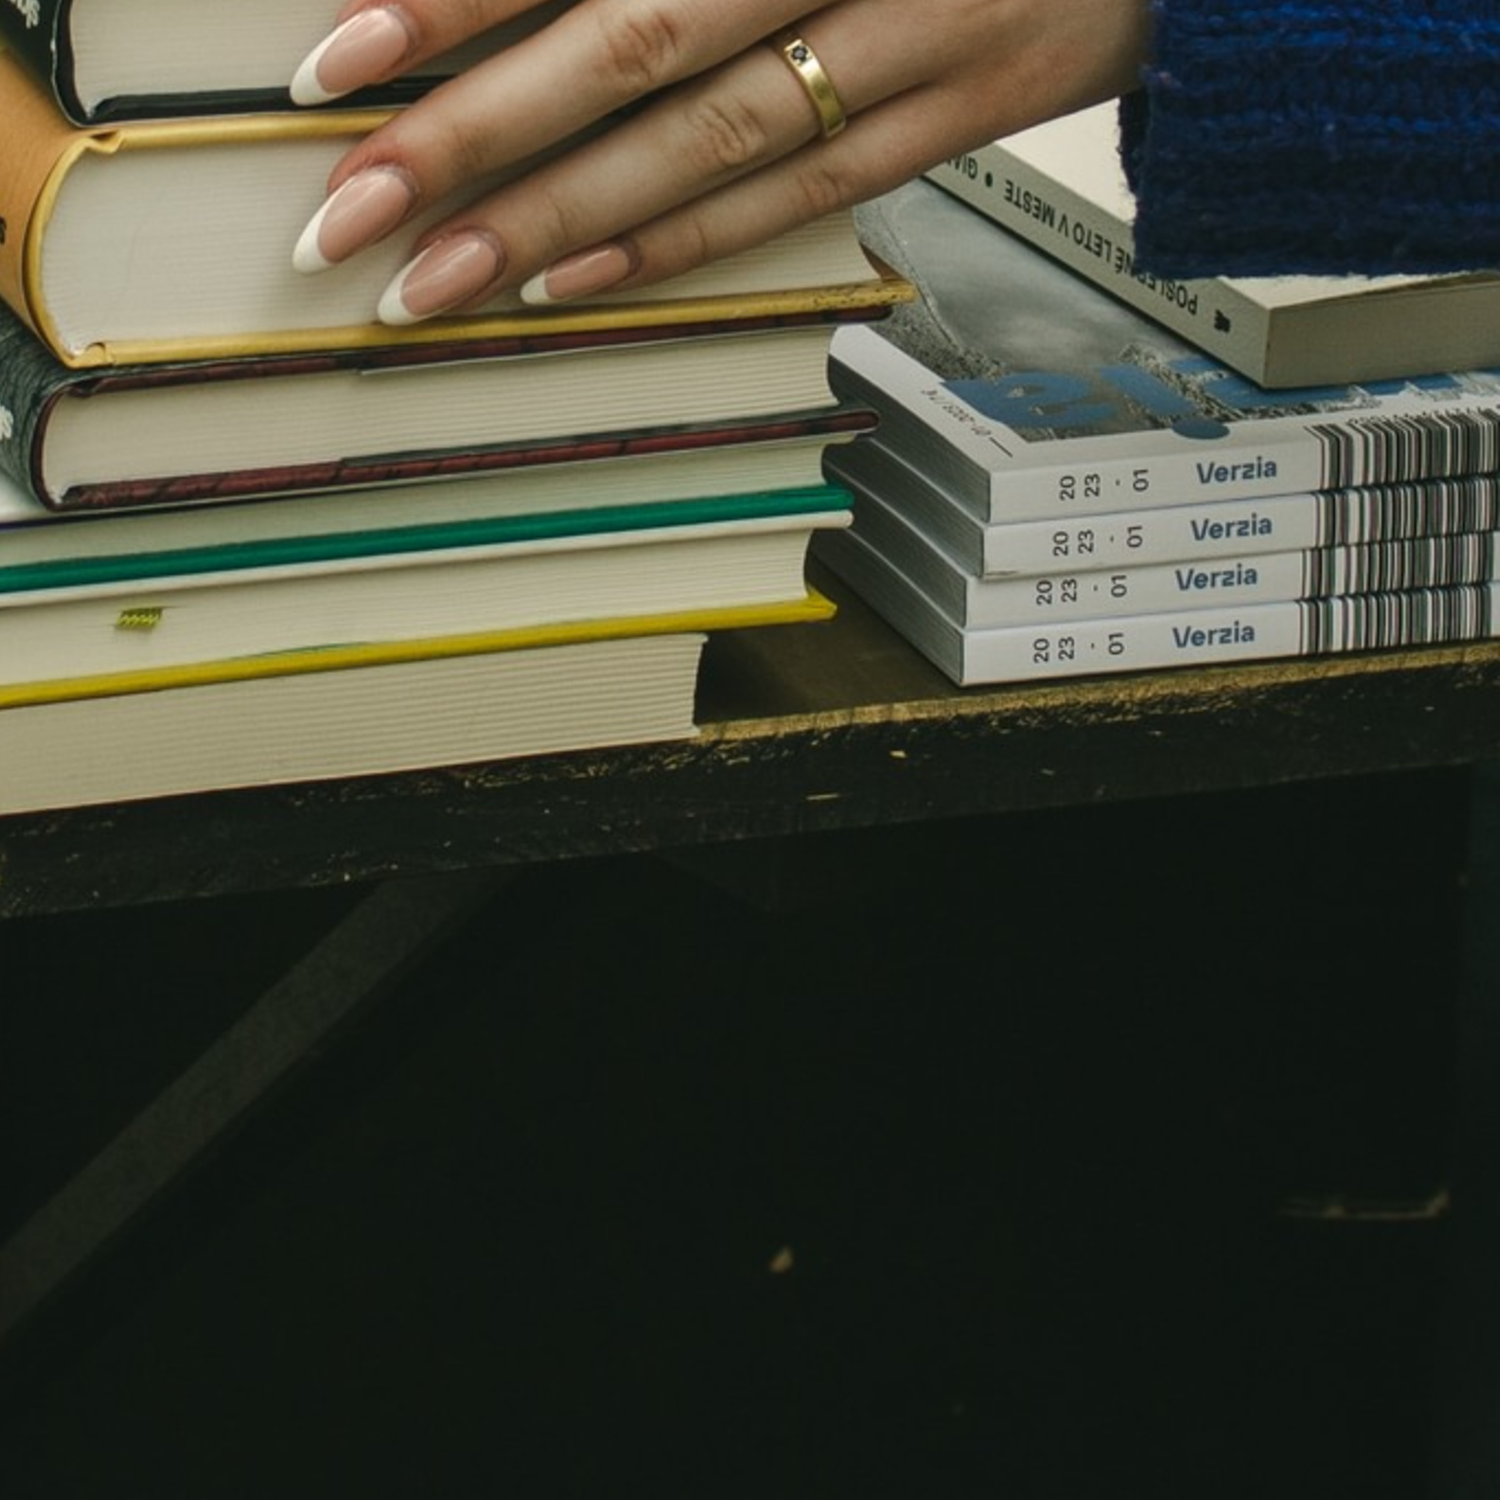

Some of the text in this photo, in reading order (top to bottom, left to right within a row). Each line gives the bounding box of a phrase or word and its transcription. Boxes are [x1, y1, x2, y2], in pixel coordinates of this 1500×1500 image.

[1003, 179, 1056, 229] MESTE
[1058, 213, 1069, 238] V
[1072, 221, 1112, 263] LETO
[1059, 475, 1076, 501] 20
[1084, 473, 1100, 498] 23
[1132, 468, 1149, 492] 01
[1196, 455, 1278, 485] Verzia
[1053, 531, 1069, 557] 20
[1077, 529, 1094, 554] 23
[1126, 524, 1143, 549] 01
[1190, 512, 1273, 542] Verzia
[1036, 579, 1053, 606] 20
[1061, 578, 1077, 603] 23
[1110, 574, 1127, 598] 01
[1175, 563, 1258, 592] Verzia
[1033, 637, 1050, 664] 20
[1058, 635, 1075, 661] 23
[1108, 631, 1124, 656] 01
[1172, 620, 1256, 649] Verzia
